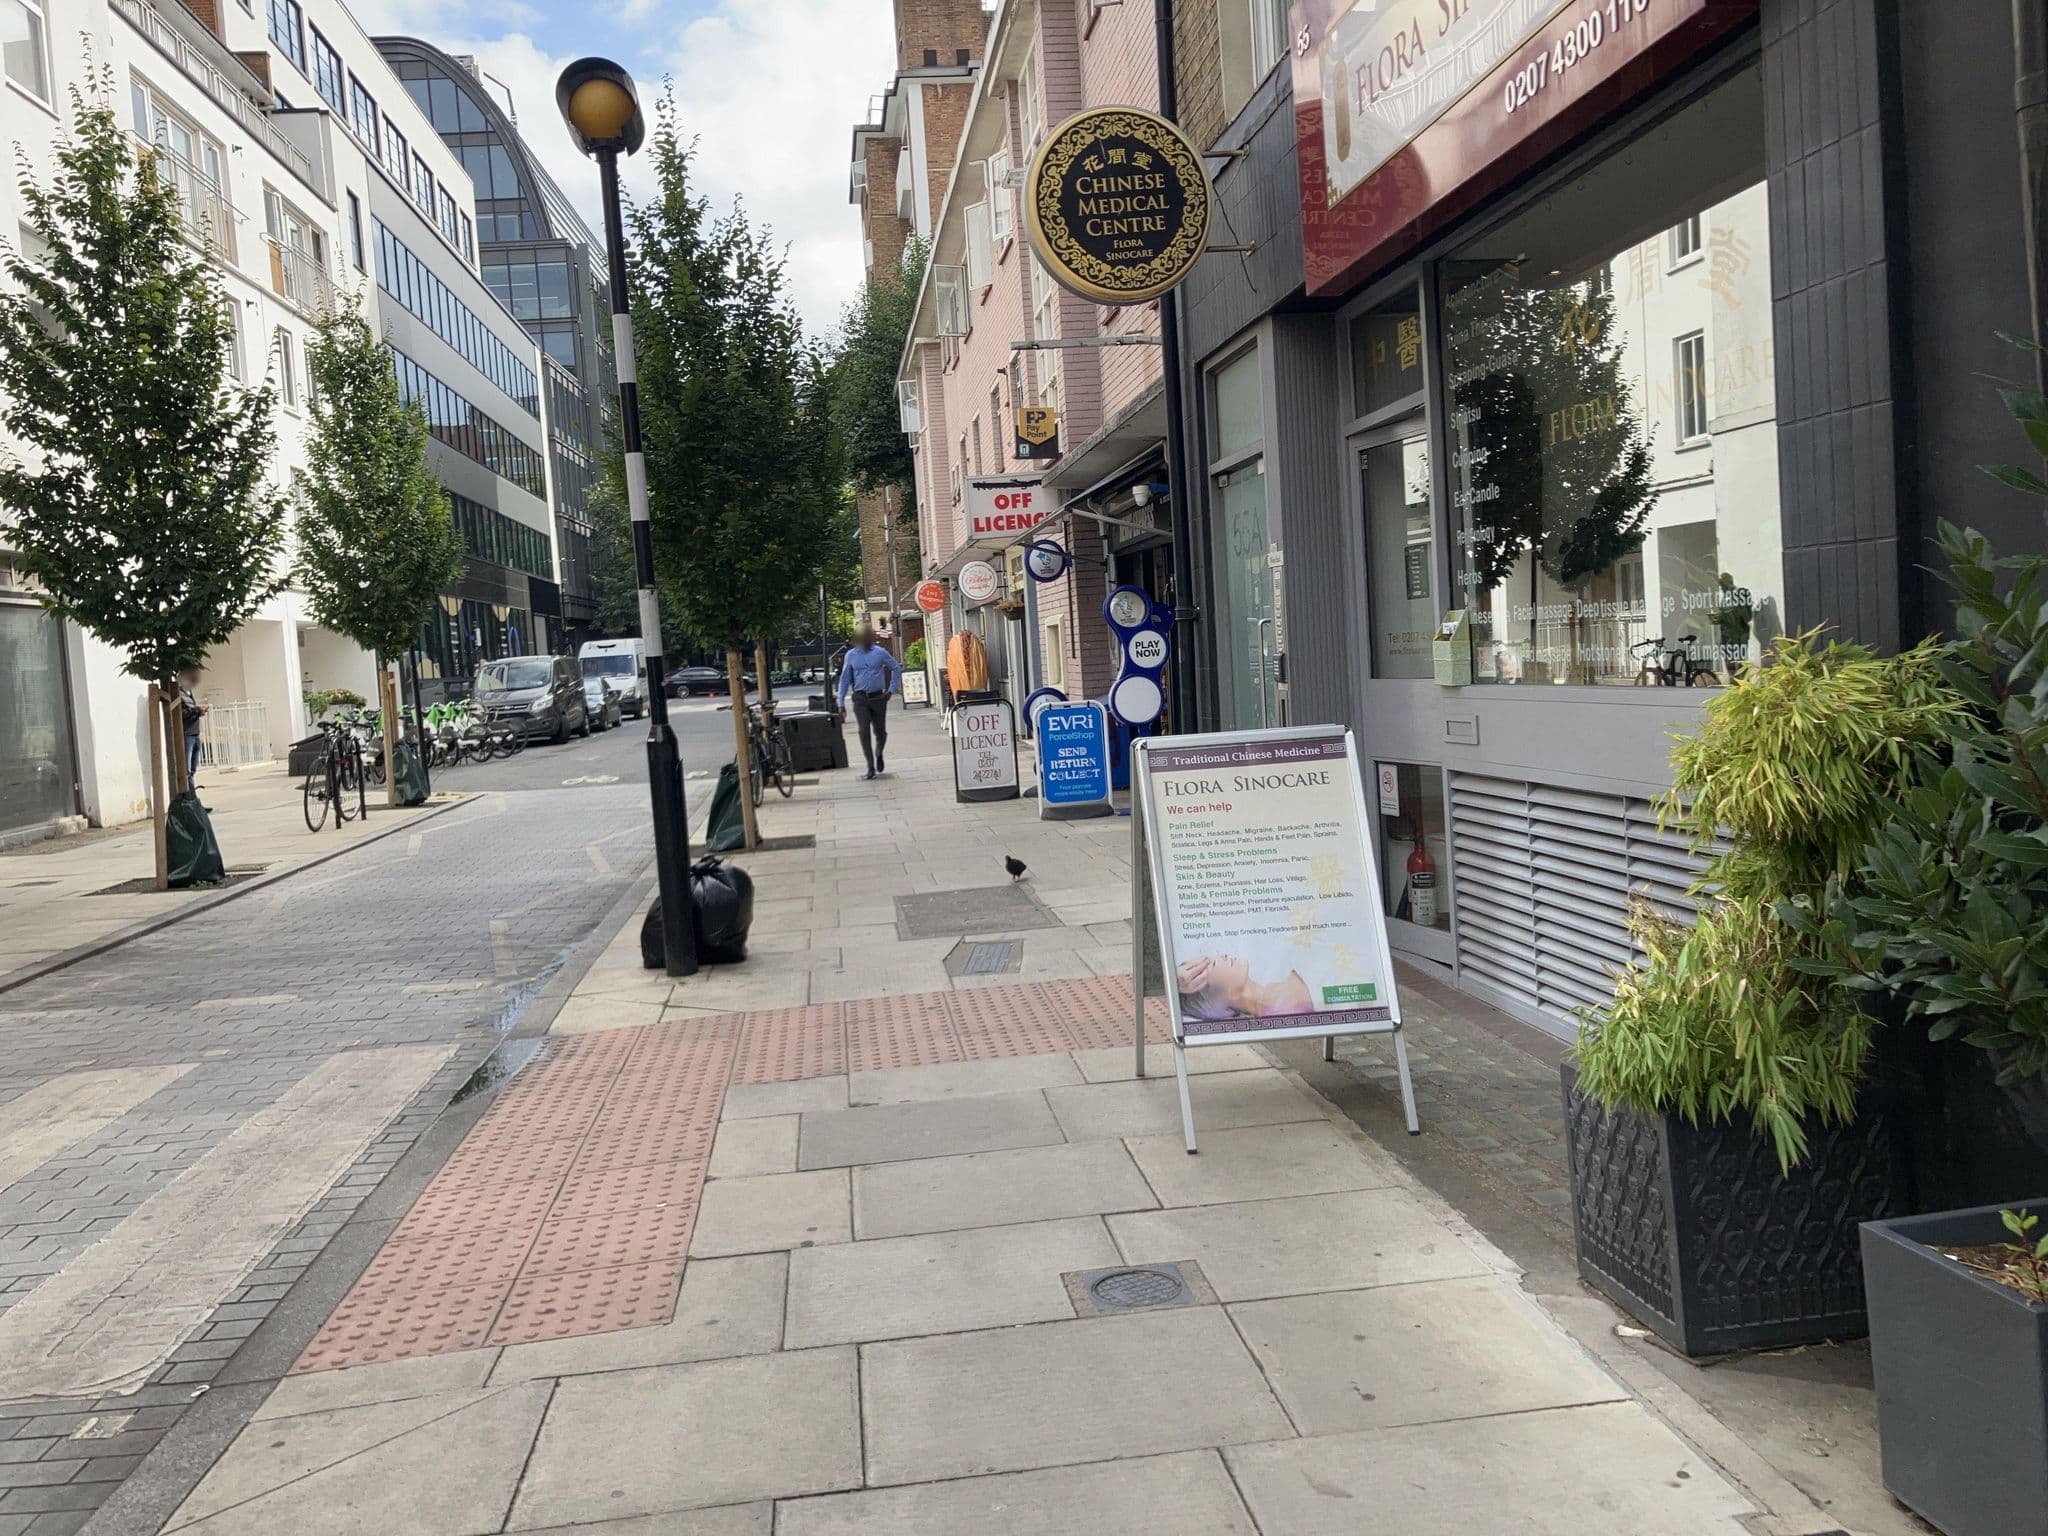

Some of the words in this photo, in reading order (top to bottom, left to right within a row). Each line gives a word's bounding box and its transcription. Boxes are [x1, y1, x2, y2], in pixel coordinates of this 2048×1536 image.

[1355, 16, 1426, 116] FLORA
[1504, 51, 1549, 113] 0207
[1551, 10, 1603, 75] 4300
[1076, 173, 1165, 195] CHINESE
[1078, 194, 1170, 217] MEDICAL
[1086, 215, 1166, 237] CENTRE
[1113, 239, 1144, 249] FLORA
[1106, 249, 1154, 261] SINOCARE
[1550, 393, 1617, 446] FLORA
[1026, 424, 1040, 433] Pay
[994, 492, 1032, 510] OFF
[1470, 482, 1500, 504] Candle
[1457, 569, 1483, 586] Herbs
[1513, 603, 1536, 623] Facial
[1537, 598, 1574, 623] massage
[1577, 597, 1600, 621] Deep
[1681, 587, 1713, 615] Sport
[1135, 640, 1160, 650] PLAY
[1135, 649, 1160, 659] NOW
[967, 714, 1000, 732] OFF
[1048, 714, 1094, 732] EVRi
[960, 733, 1008, 751] LICENCE
[1048, 731, 1095, 742] ParcelShop
[1058, 746, 1088, 758] SEND
[1173, 751, 1230, 766] Traditional
[1232, 748, 1272, 761] Chinese
[1275, 745, 1320, 758] Medicine
[1050, 757, 1096, 770] RETURN
[1048, 768, 1101, 781] COLLECT
[1163, 779, 1224, 797] FLORA
[1234, 770, 1331, 792] SINOCARE
[1167, 805, 1184, 815] We
[1187, 804, 1206, 814] can
[1208, 802, 1232, 813] help
[1168, 822, 1188, 831] Pain
[1189, 819, 1215, 830] Relief
[1172, 853, 1197, 863] Sleep
[1199, 852, 1206, 860] &
[1207, 850, 1235, 860] Stress
[1236, 846, 1279, 857] Problems
[1175, 872, 1195, 882] Skin
[1196, 871, 1204, 880] &
[1205, 869, 1235, 880] Beauty
[1178, 891, 1199, 901] Male
[1200, 890, 1207, 899] &
[1209, 889, 1240, 899] Female
[1242, 886, 1283, 896] Problems
[1182, 921, 1212, 931] Others
[1224, 929, 1239, 938] Stop
[1299, 923, 1311, 931] and
[1311, 921, 1330, 930] much
[1338, 985, 1360, 994] FREE
